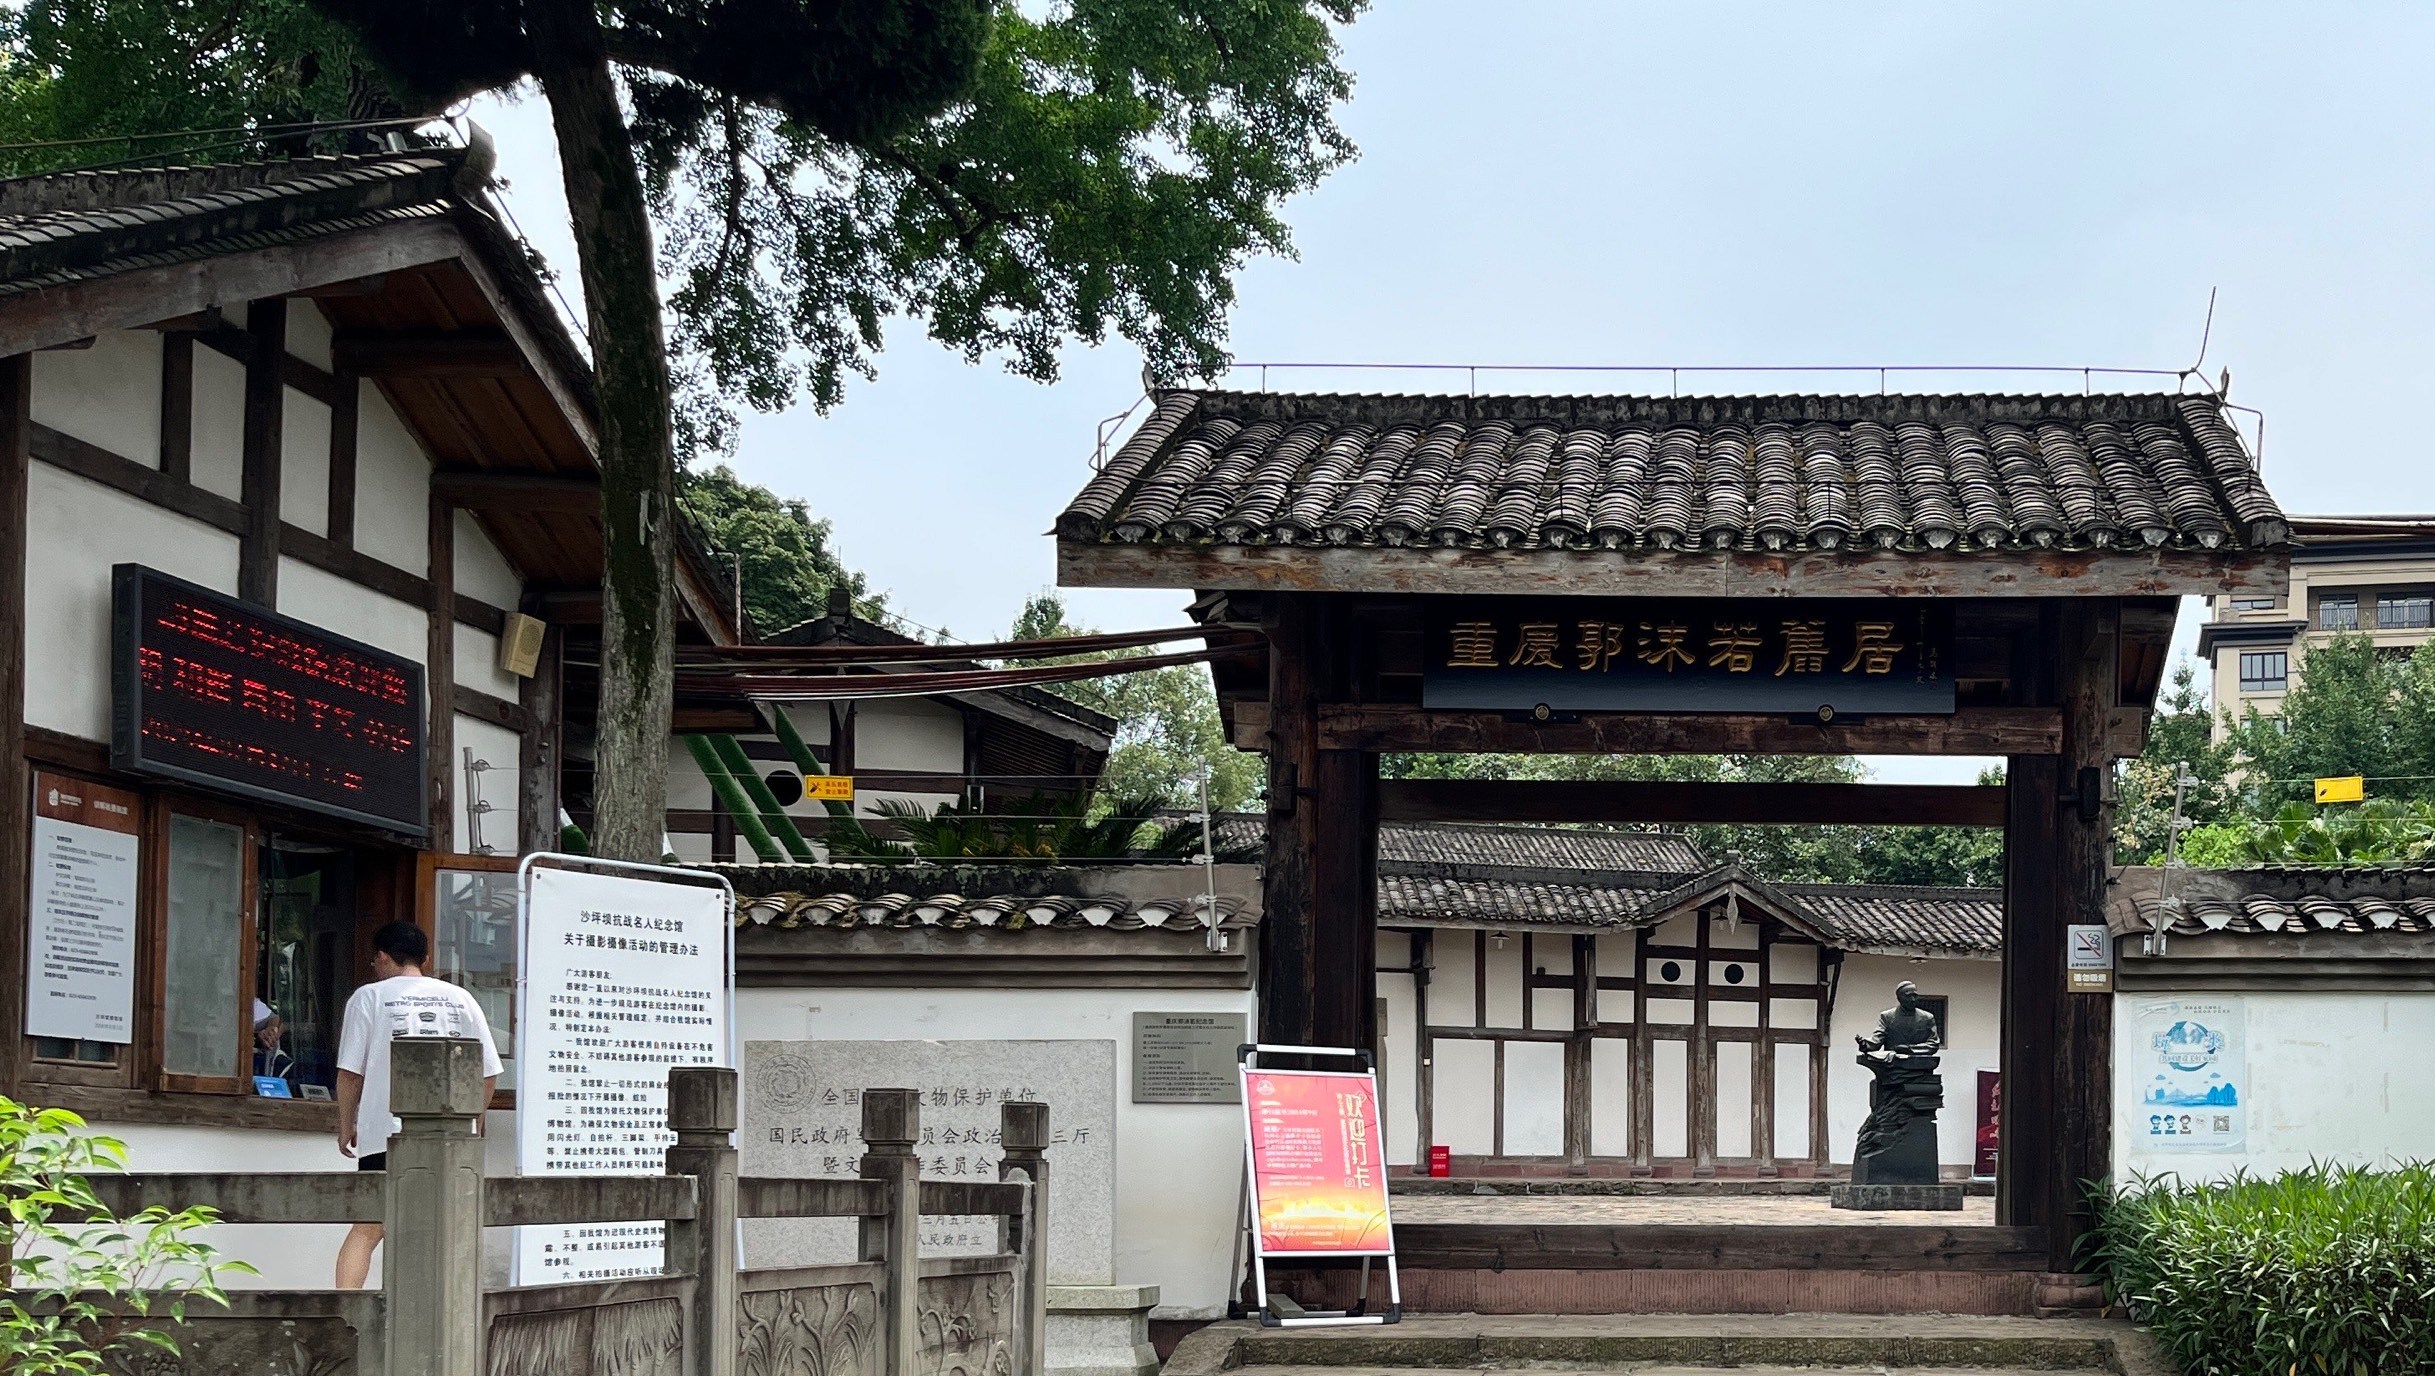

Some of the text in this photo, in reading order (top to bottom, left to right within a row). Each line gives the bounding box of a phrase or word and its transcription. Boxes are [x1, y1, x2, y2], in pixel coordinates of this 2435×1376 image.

[580, 910, 684, 933] 沙坪坝抗战名人纪念馆
[564, 932, 699, 956] 关于摄影摄像活动的管理办法
[821, 1088, 1037, 1108] 全国物保护单位
[768, 1126, 1091, 1146] 国民政府员会政治三厅
[1345, 1093, 1371, 1190] 欢迎打卡
[823, 1156, 992, 1175] 暨文委员会
